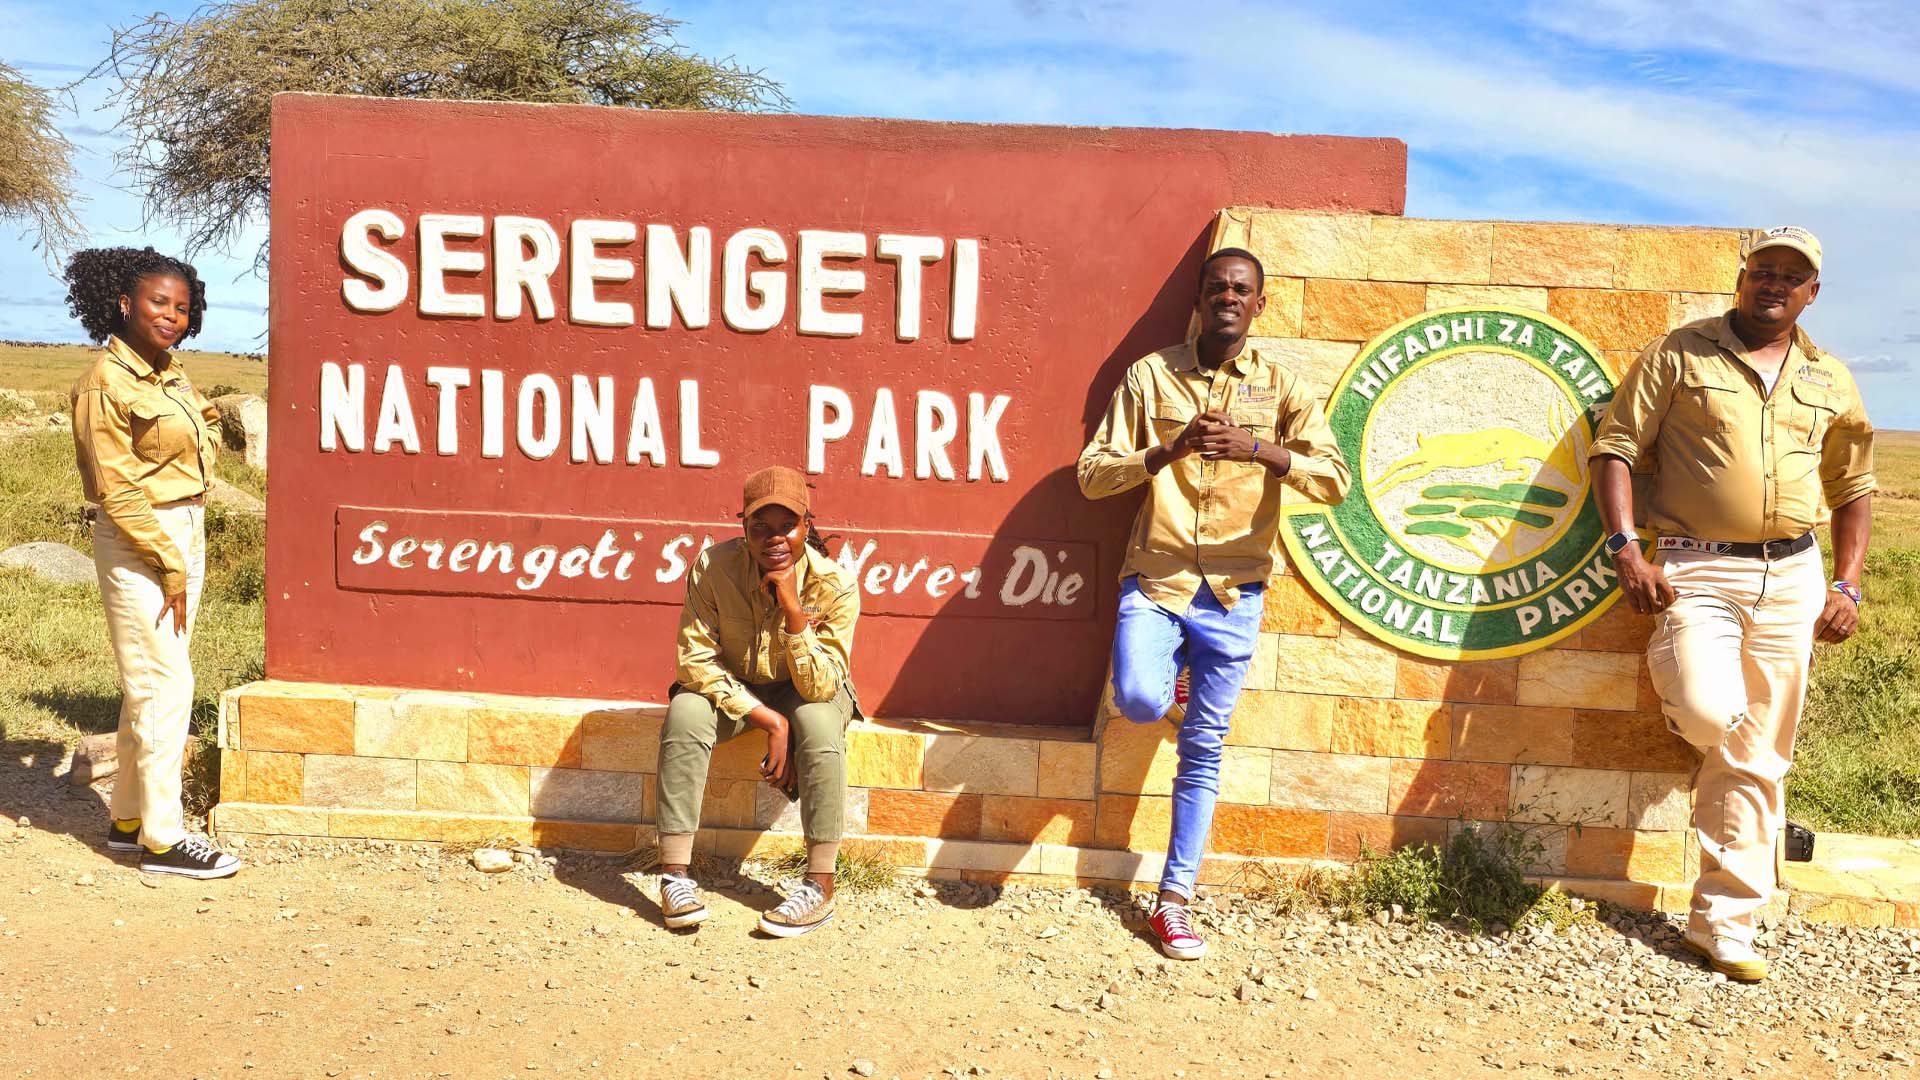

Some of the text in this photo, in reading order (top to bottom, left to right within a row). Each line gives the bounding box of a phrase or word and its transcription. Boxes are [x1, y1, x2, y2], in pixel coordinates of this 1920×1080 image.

[341, 207, 982, 341] SERENGETI
[319, 361, 1013, 482] NATIONAL PARK
[1350, 317, 1612, 422] HIFADHI ZA TAIFA
[999, 545, 1084, 606] Die
[1300, 522, 1461, 644] NATIONAL
[1373, 541, 1559, 605] TANZANIA
